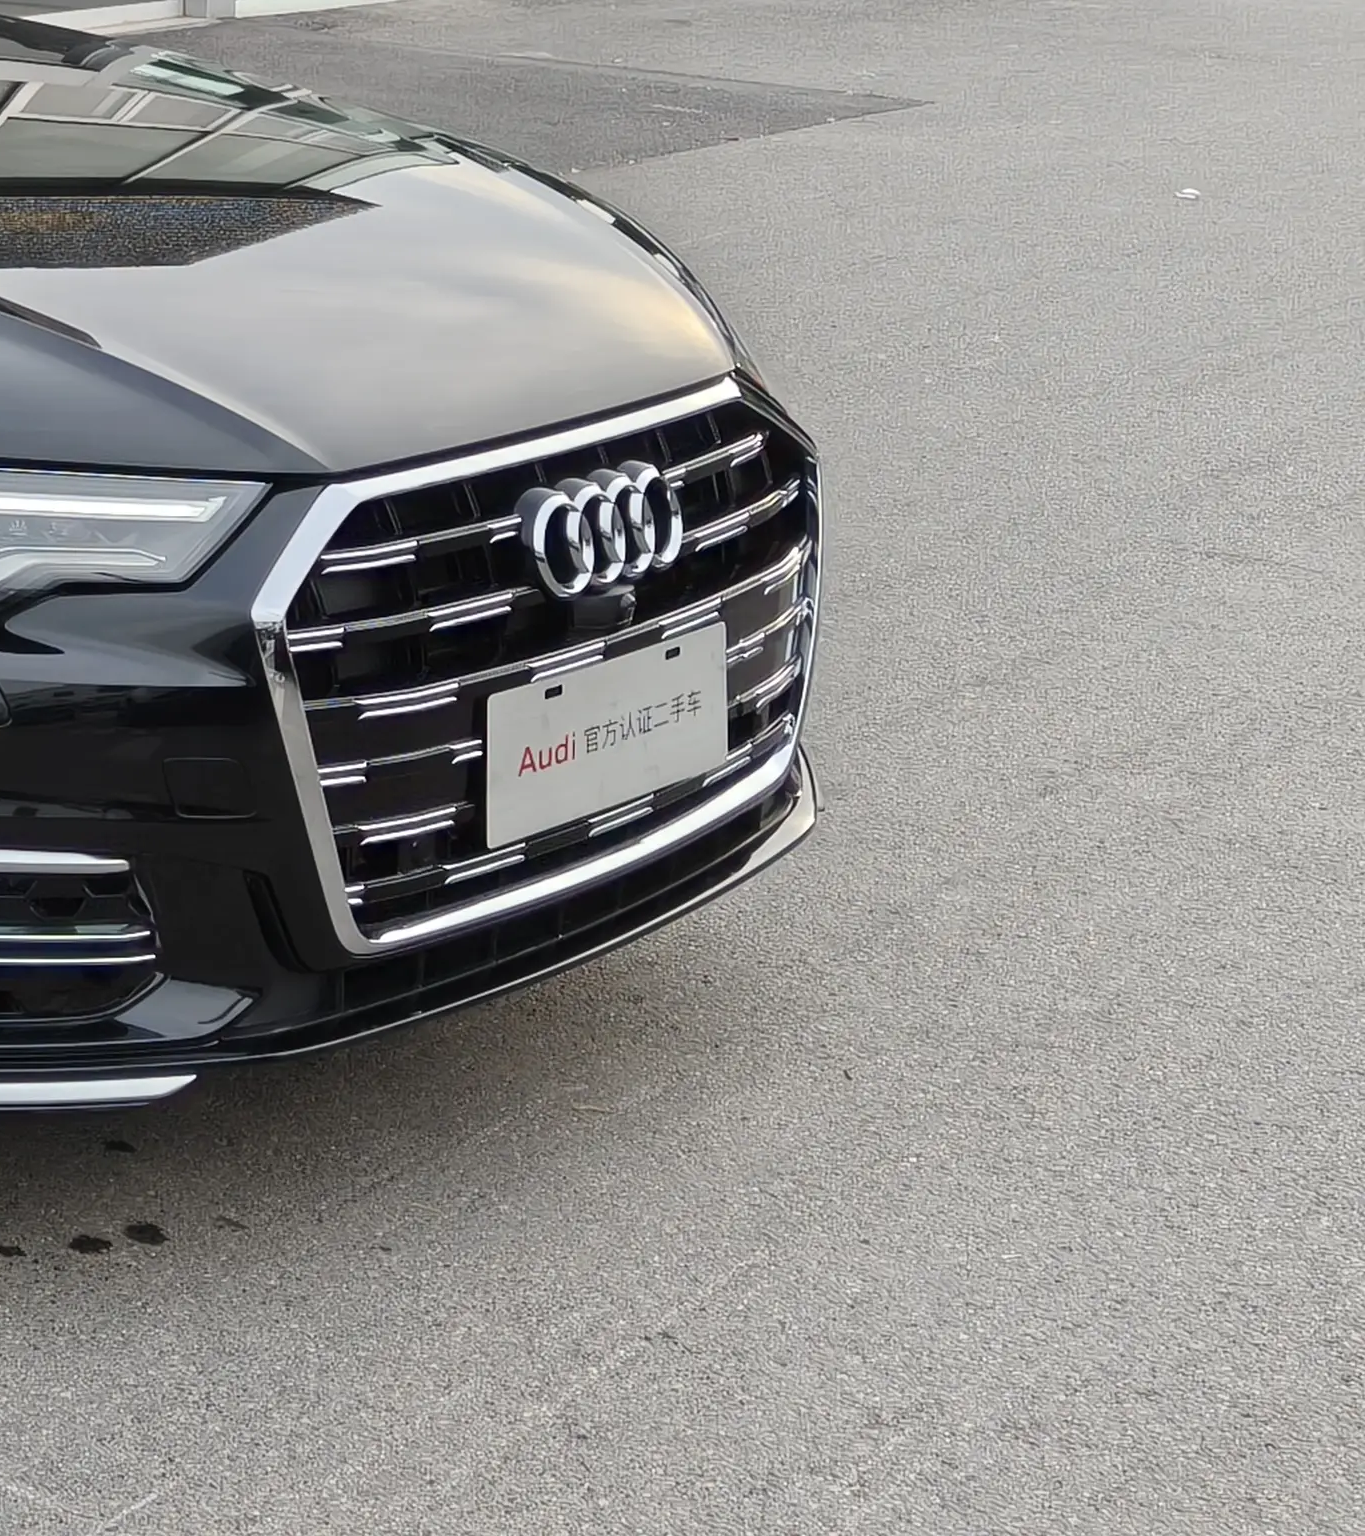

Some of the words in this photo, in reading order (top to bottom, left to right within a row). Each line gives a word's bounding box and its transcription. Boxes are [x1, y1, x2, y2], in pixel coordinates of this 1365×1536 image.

[517, 731, 577, 777] Audi
[583, 689, 703, 755] 官方认证二手车
